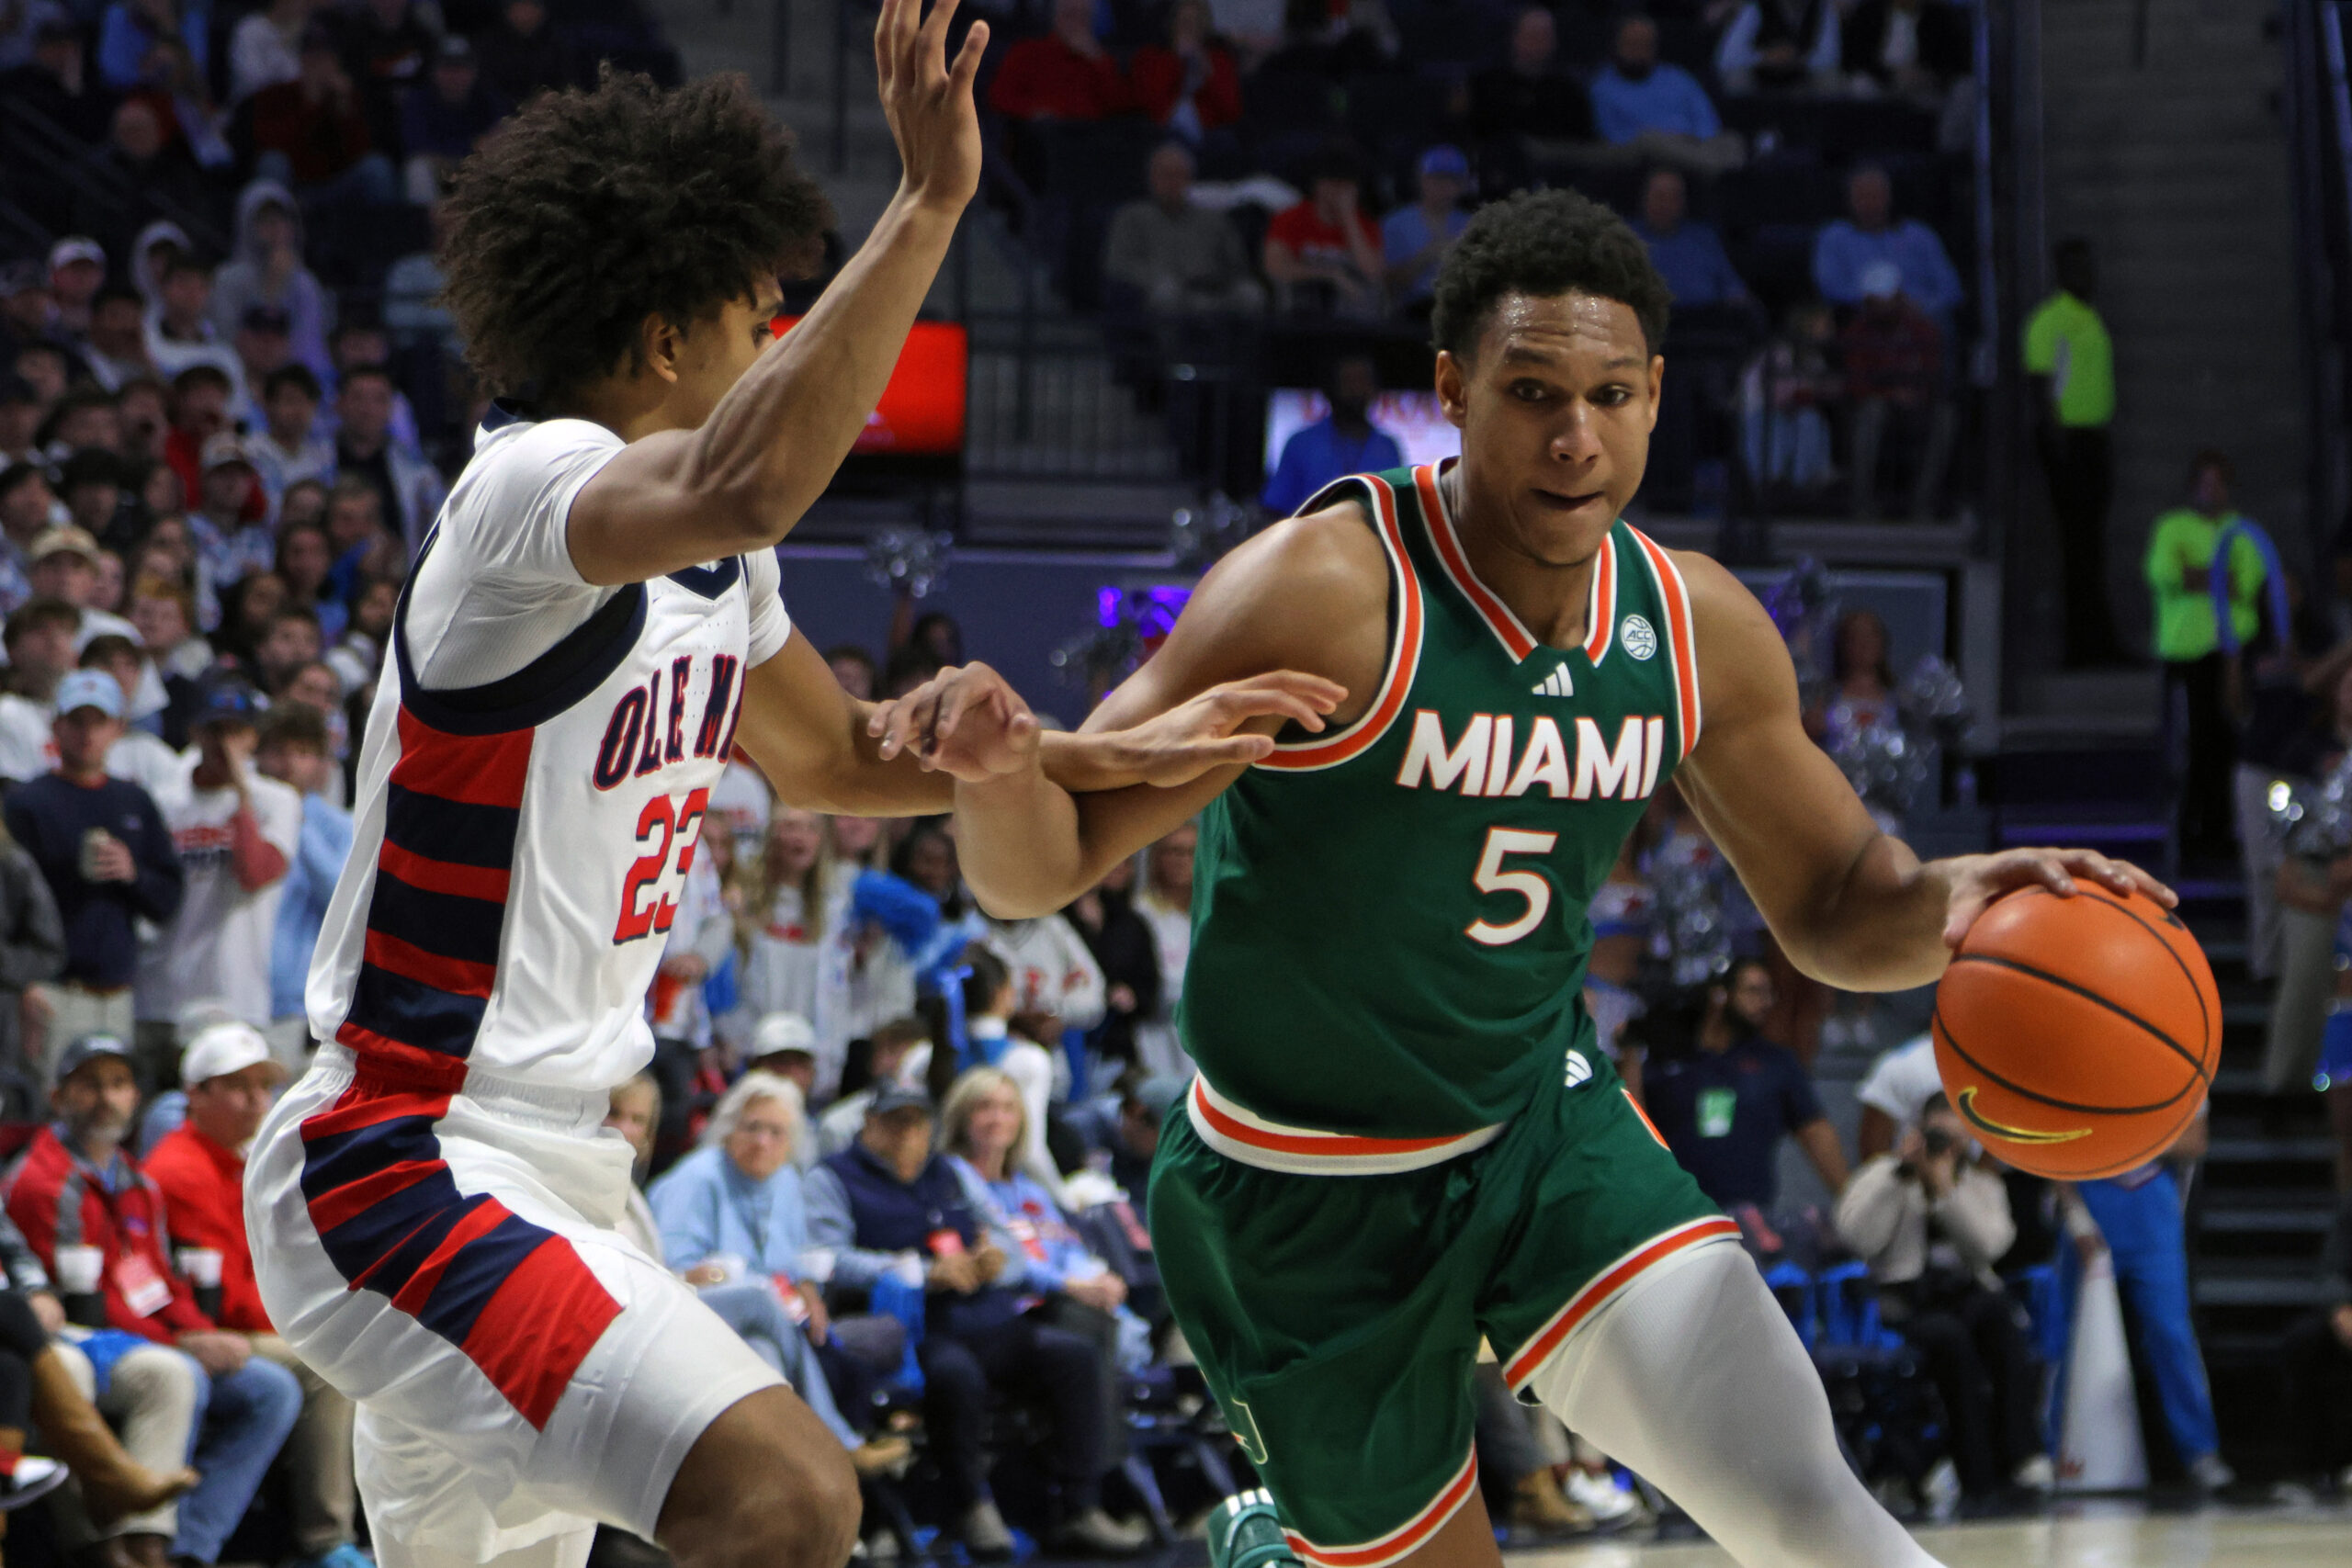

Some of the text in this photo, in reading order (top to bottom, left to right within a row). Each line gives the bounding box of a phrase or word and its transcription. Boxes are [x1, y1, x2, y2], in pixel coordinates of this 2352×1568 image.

[1626, 629, 1652, 640] ACC
[594, 654, 693, 792] OLE
[1396, 708, 1664, 800] MIAMI
[613, 787, 709, 946] 23
[1464, 827, 1559, 946] 5
